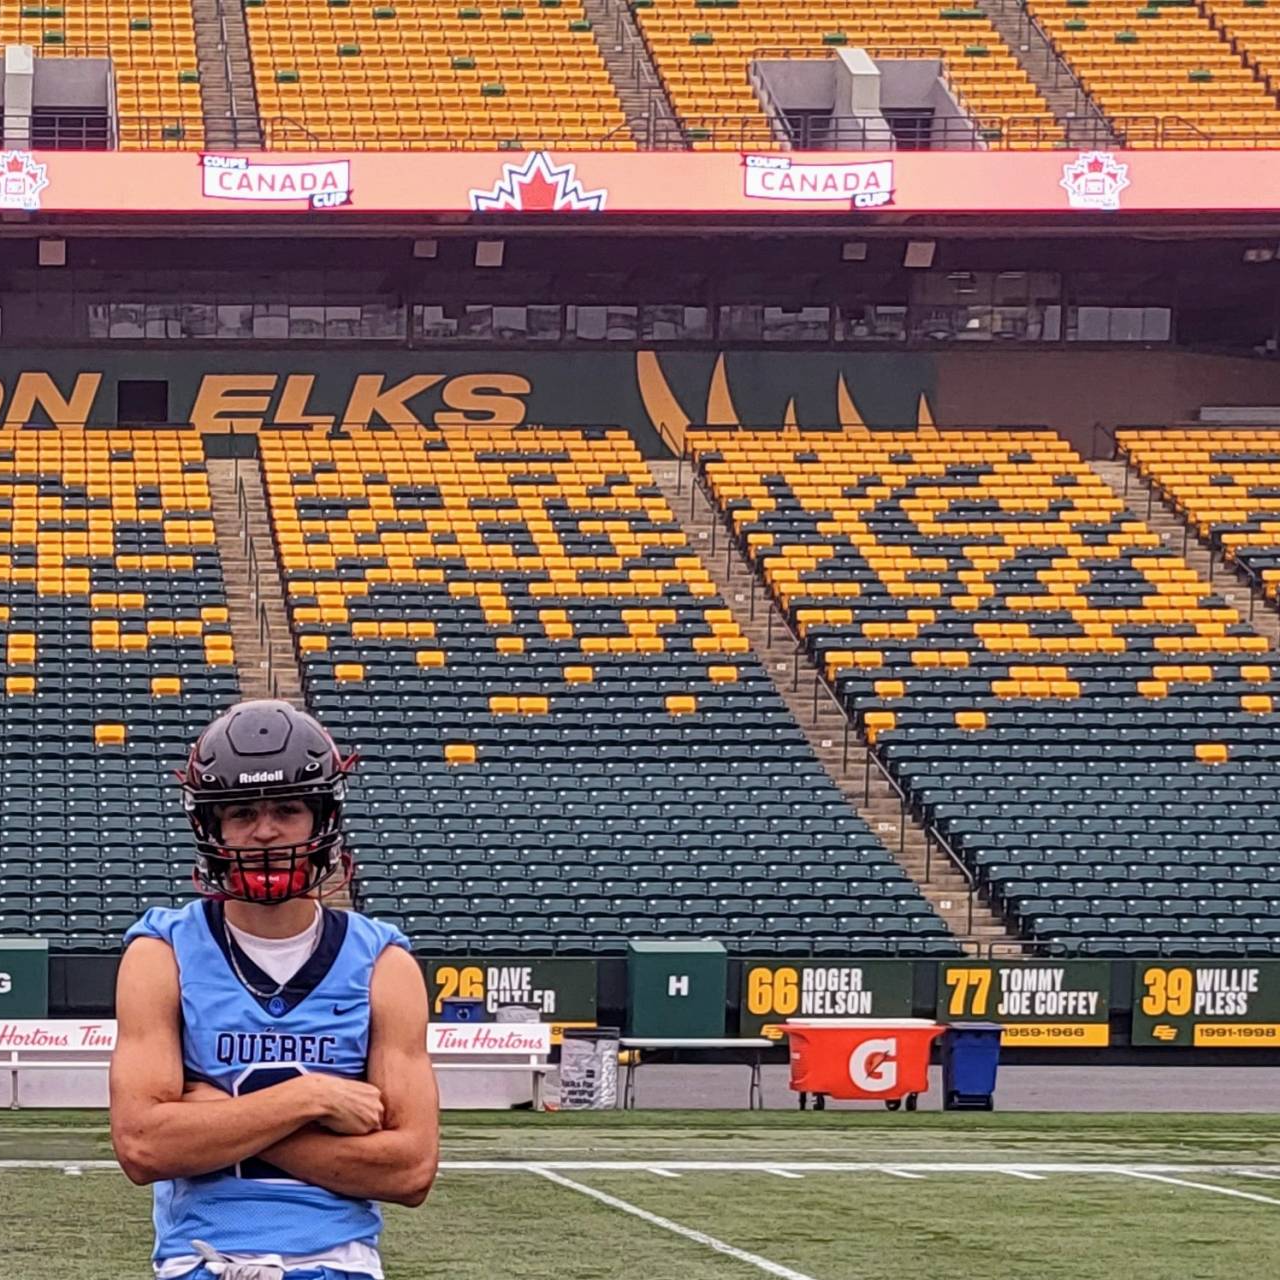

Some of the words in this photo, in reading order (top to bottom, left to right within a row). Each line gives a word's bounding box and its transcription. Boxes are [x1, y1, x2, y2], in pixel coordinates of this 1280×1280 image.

[219, 171, 338, 192] CANADA
[761, 171, 881, 192] CANADA
[312, 193, 347, 208] CUP
[189, 373, 532, 434] ELKS
[239, 770, 283, 783] Riddell
[487, 967, 532, 990] DAVE
[668, 975, 689, 996] H
[802, 968, 863, 991] ROGER
[999, 968, 1064, 992] TOMMY
[1196, 969, 1259, 992] WILLIE
[748, 967, 799, 1015] 66
[946, 969, 992, 1015] 77
[1142, 968, 1193, 1016] 39
[801, 991, 872, 1015] NELSON
[997, 992, 1031, 1015] JOE
[1034, 991, 1099, 1015] COFFEY
[1194, 992, 1248, 1015] PLESS
[79, 1025, 113, 1046] Tim
[435, 1028, 469, 1049] Tim
[472, 1027, 544, 1049] Hortons
[1003, 1028, 1085, 1037] 1959-1966
[1199, 1027, 1276, 1038] 1991-1998
[849, 1037, 897, 1092] G
